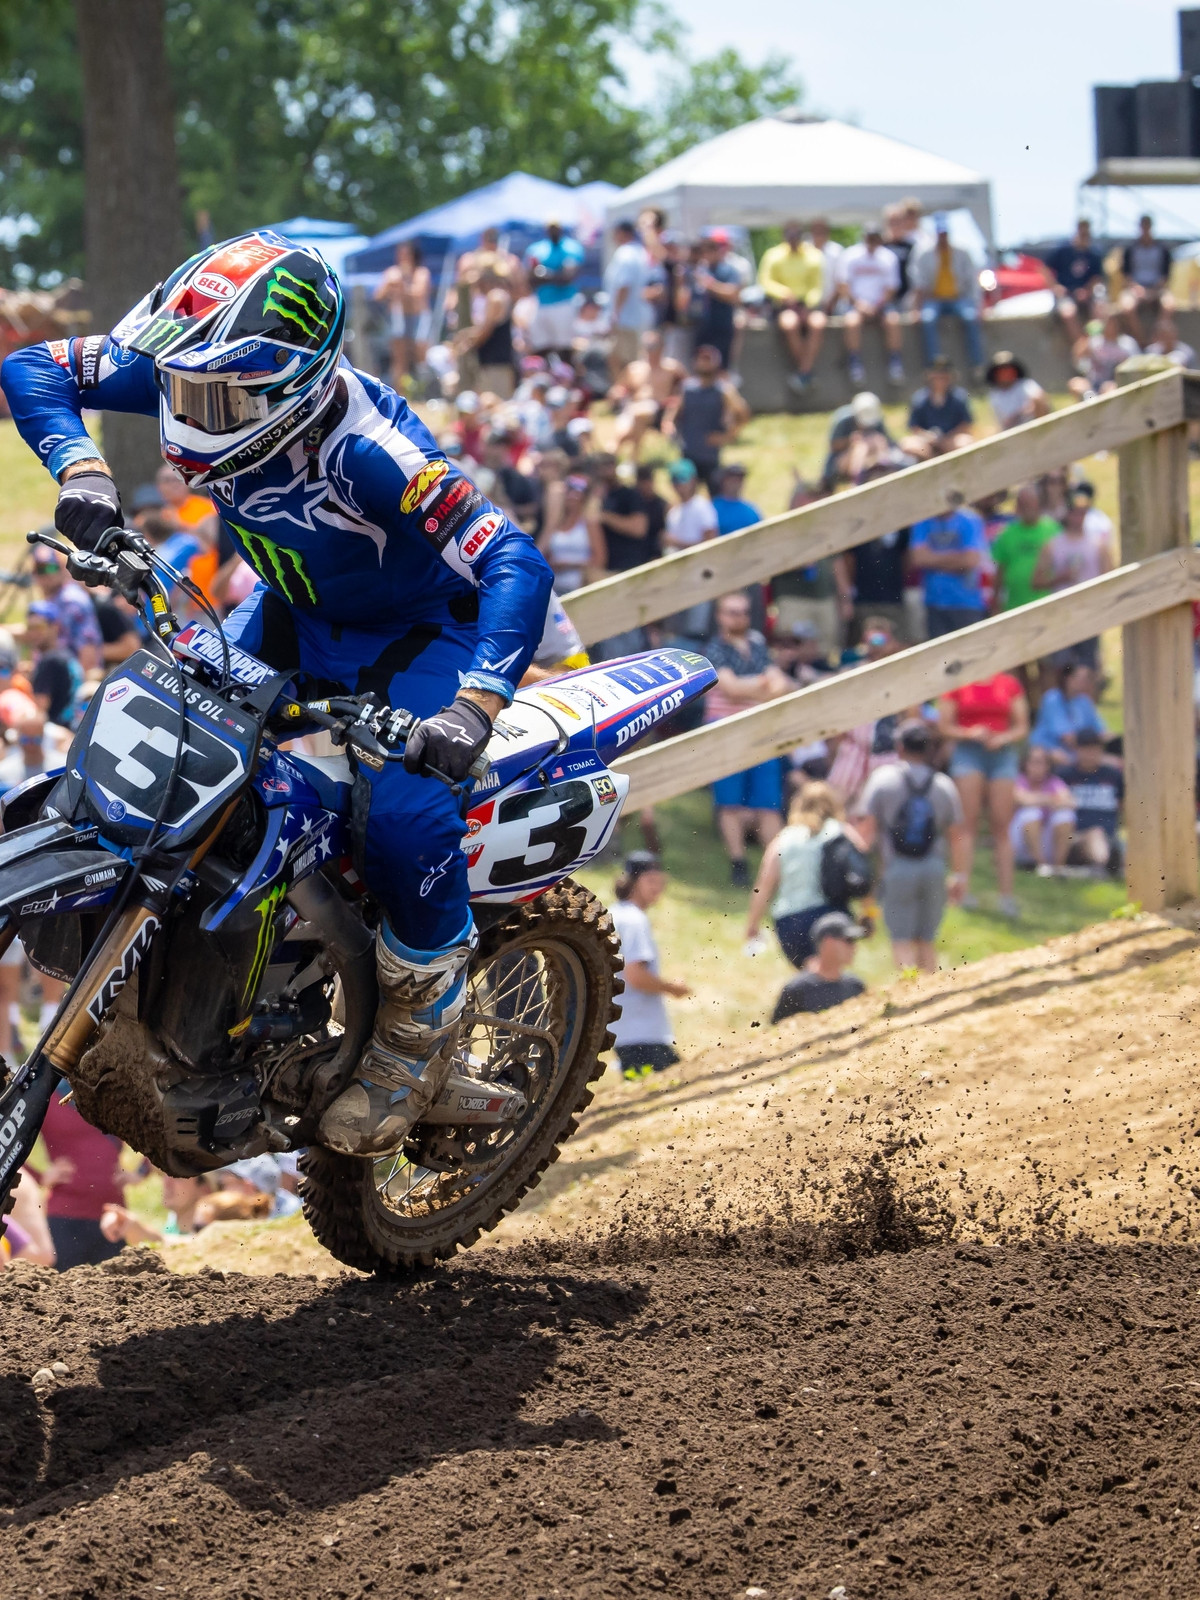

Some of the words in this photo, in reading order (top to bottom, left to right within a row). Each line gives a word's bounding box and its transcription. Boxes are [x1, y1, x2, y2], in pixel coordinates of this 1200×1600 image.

[198, 277, 228, 296] BELL
[207, 341, 261, 371] apdesigns
[238, 406, 309, 459] MONSTER
[198, 700, 224, 721] OIL
[616, 689, 685, 748] DUNLOP
[87, 695, 239, 825] 3
[567, 758, 596, 772] TOMAC
[596, 778, 612, 794] 50
[75, 831, 98, 843] TOMAC
[488, 781, 593, 886] 3
[91, 868, 117, 884] YAMAHA
[40, 965, 61, 978] Twin
[457, 1096, 490, 1111] VORTEX
